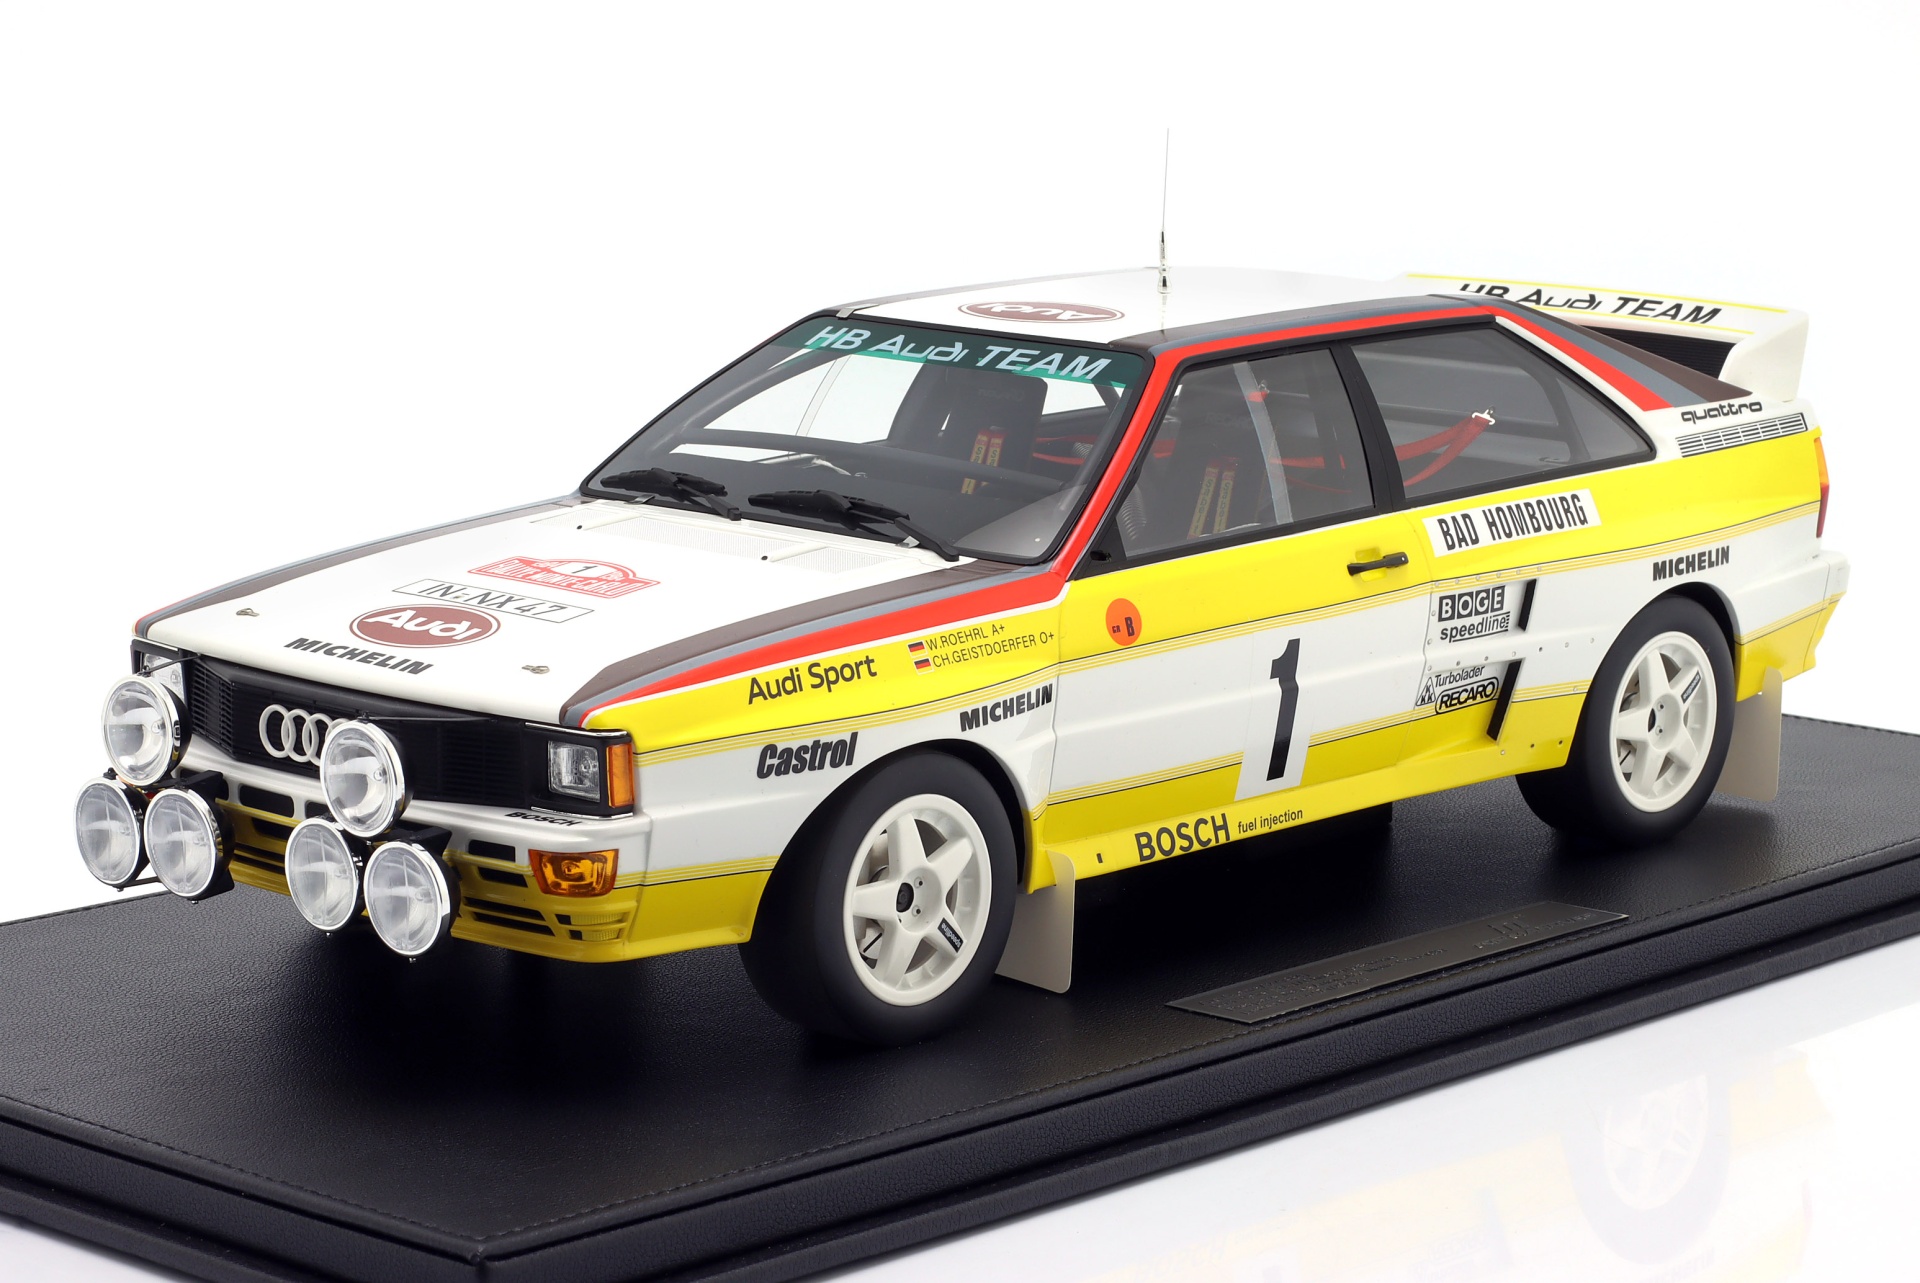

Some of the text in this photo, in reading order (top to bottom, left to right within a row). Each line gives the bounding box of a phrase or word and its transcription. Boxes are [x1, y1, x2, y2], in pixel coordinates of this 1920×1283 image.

[977, 303, 1113, 320] Audi
[1515, 288, 1602, 311] Audi
[1611, 296, 1722, 325] TEAM
[804, 325, 1112, 380] HB Audi TEAM
[1680, 400, 1763, 424] quattro
[1436, 493, 1589, 552] BAD HOMBOURG
[1652, 546, 1730, 582] MICHELIN
[513, 602, 568, 616] 47
[1439, 586, 1504, 621] BOGE
[362, 609, 483, 641] Audi
[925, 623, 1005, 651] W.ROEHRL A+
[1124, 616, 1136, 637] B
[1439, 613, 1508, 643] speedline
[283, 637, 435, 675] MICHELIN
[932, 633, 1037, 668] CH.GEISTDOERFER
[747, 655, 878, 706] Audi Sport
[1434, 665, 1485, 688] Turbolader
[959, 683, 1054, 732] MICHELIN
[1266, 637, 1301, 782] 1
[1438, 680, 1496, 711] RECARO
[756, 732, 859, 779] Castrol
[504, 811, 583, 827] BOSCH
[1134, 809, 1304, 863] BOSCH fuel injection
